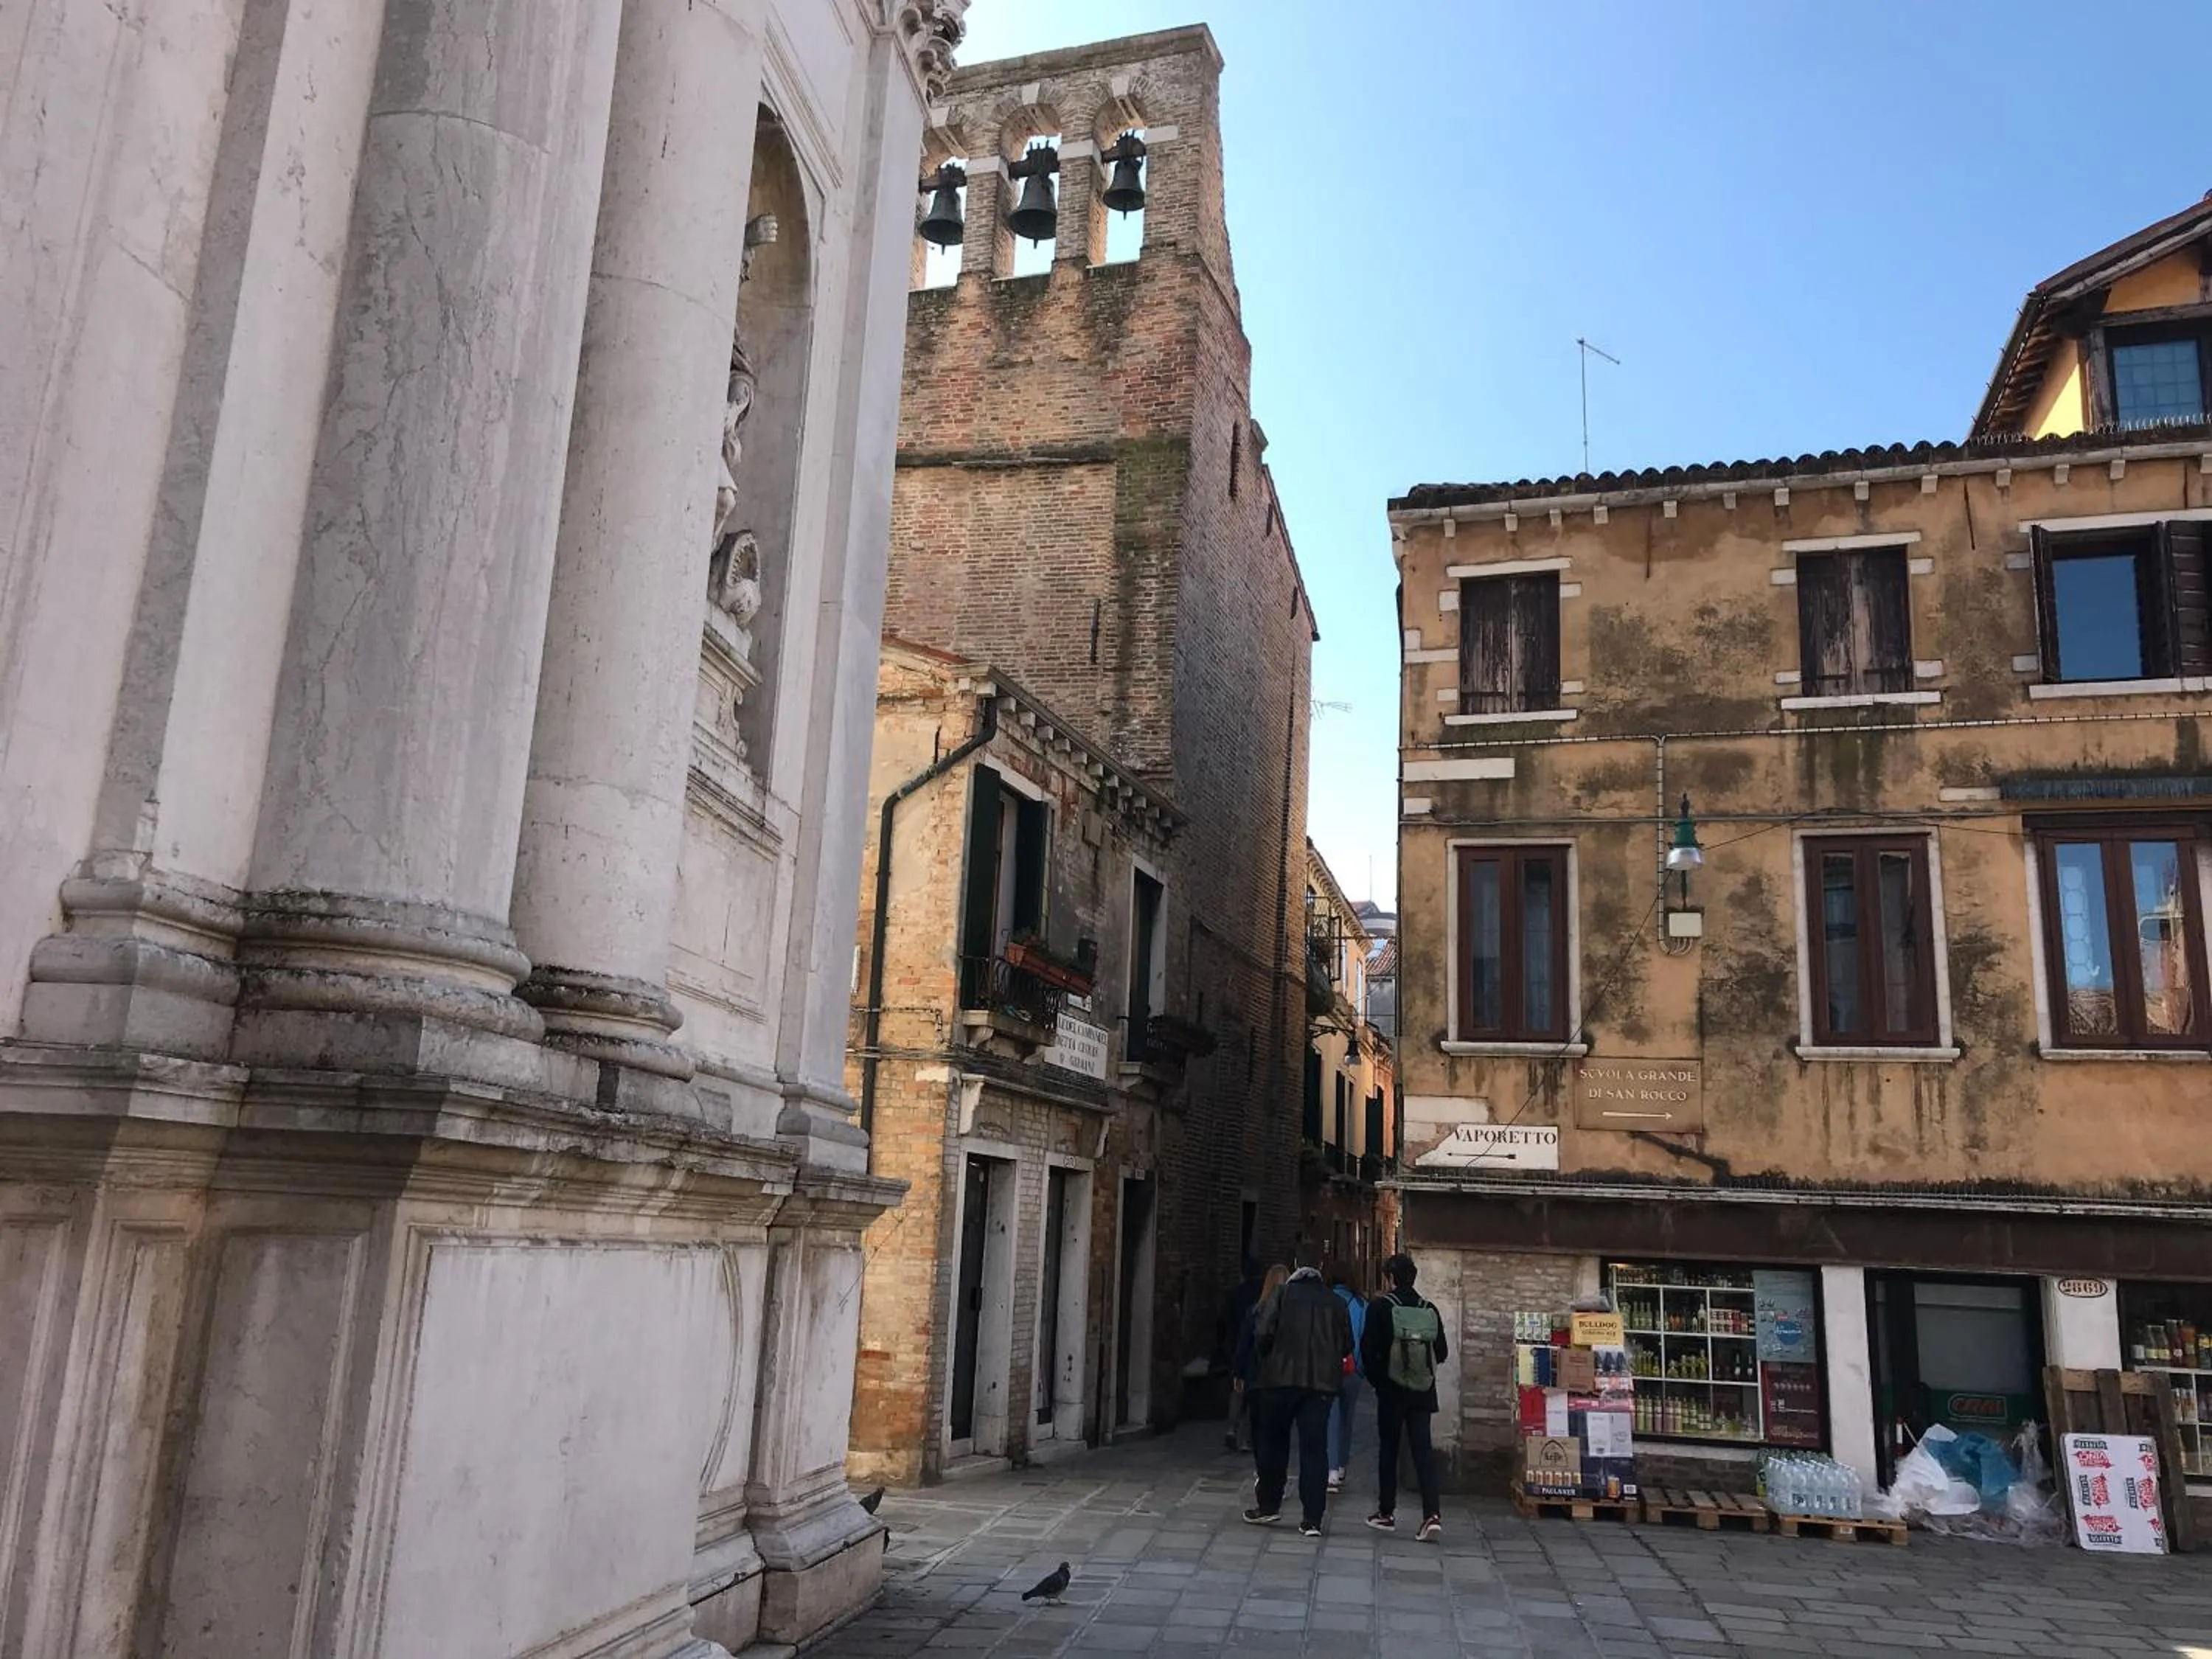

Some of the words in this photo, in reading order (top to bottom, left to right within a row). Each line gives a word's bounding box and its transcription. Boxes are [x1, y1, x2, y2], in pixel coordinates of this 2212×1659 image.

[1638, 1070, 1697, 1082] GRANDE
[1589, 1088, 1601, 1099] DI
[1606, 1088, 1635, 1099] SAN
[1640, 1089, 1688, 1102] ROCCO
[1455, 1129, 1557, 1146] VAPORETTO
